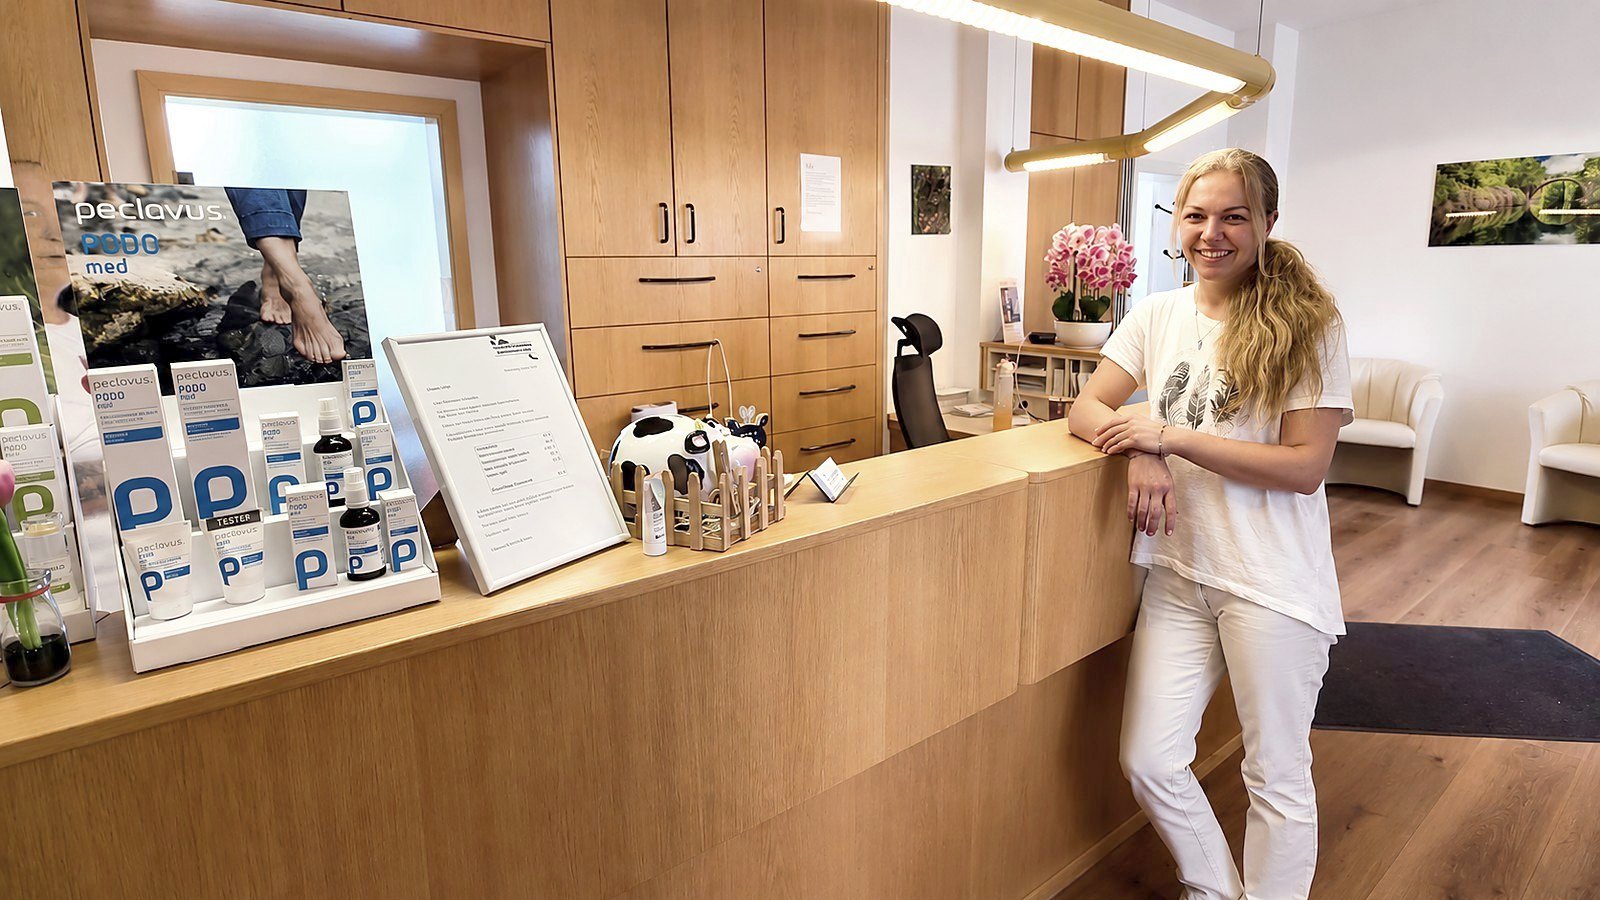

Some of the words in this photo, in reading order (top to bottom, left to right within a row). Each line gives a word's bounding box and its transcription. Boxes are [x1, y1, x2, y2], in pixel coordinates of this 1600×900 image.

[75, 198, 227, 225] peclavus.
[81, 233, 160, 256] PODO
[86, 258, 128, 275] med
[176, 369, 232, 384] peclavus.
[178, 383, 207, 394] PODO
[95, 391, 125, 402] PODO
[217, 514, 251, 527] TESTER
